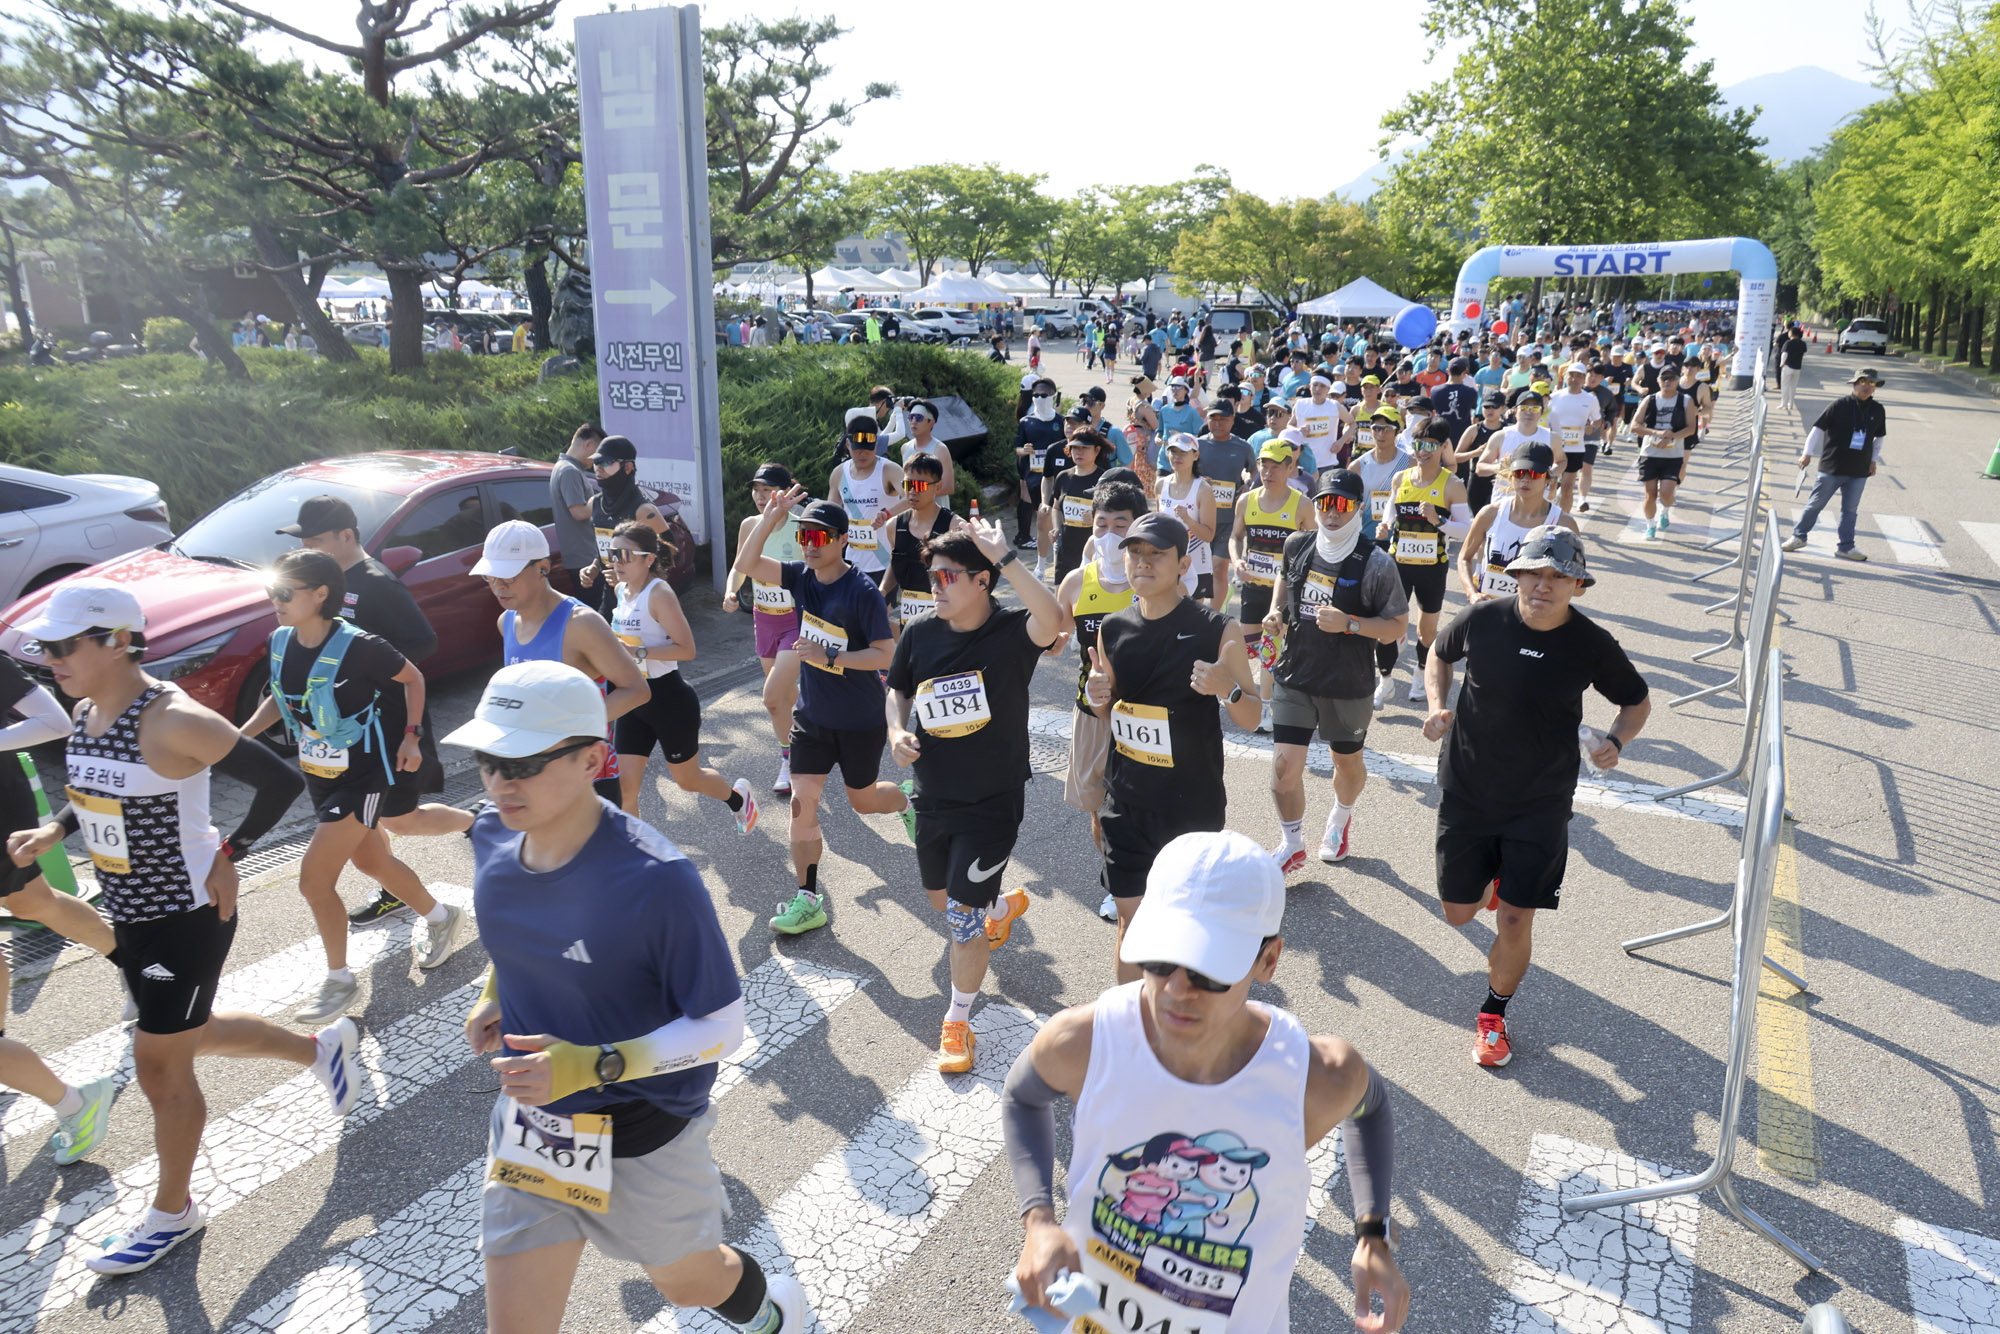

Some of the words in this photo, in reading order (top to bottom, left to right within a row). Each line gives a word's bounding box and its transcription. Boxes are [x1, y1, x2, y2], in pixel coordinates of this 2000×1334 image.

[600, 46, 664, 249] 남문
[1554, 251, 1671, 276] START
[606, 342, 683, 371] 사전무인
[609, 382, 685, 411] 전용출구
[848, 528, 873, 540] 2151
[1250, 527, 1288, 539] 건국에이스
[1253, 554, 1270, 563] 0405
[1401, 542, 1434, 554] 1305
[756, 589, 786, 603] 2031
[1519, 647, 1545, 658] 2XU
[942, 679, 971, 693] 0439
[924, 693, 982, 720] 1184
[1115, 719, 1163, 746] 1161
[84, 766, 126, 788] 유러닝
[1162, 1257, 1225, 1291] 0433
